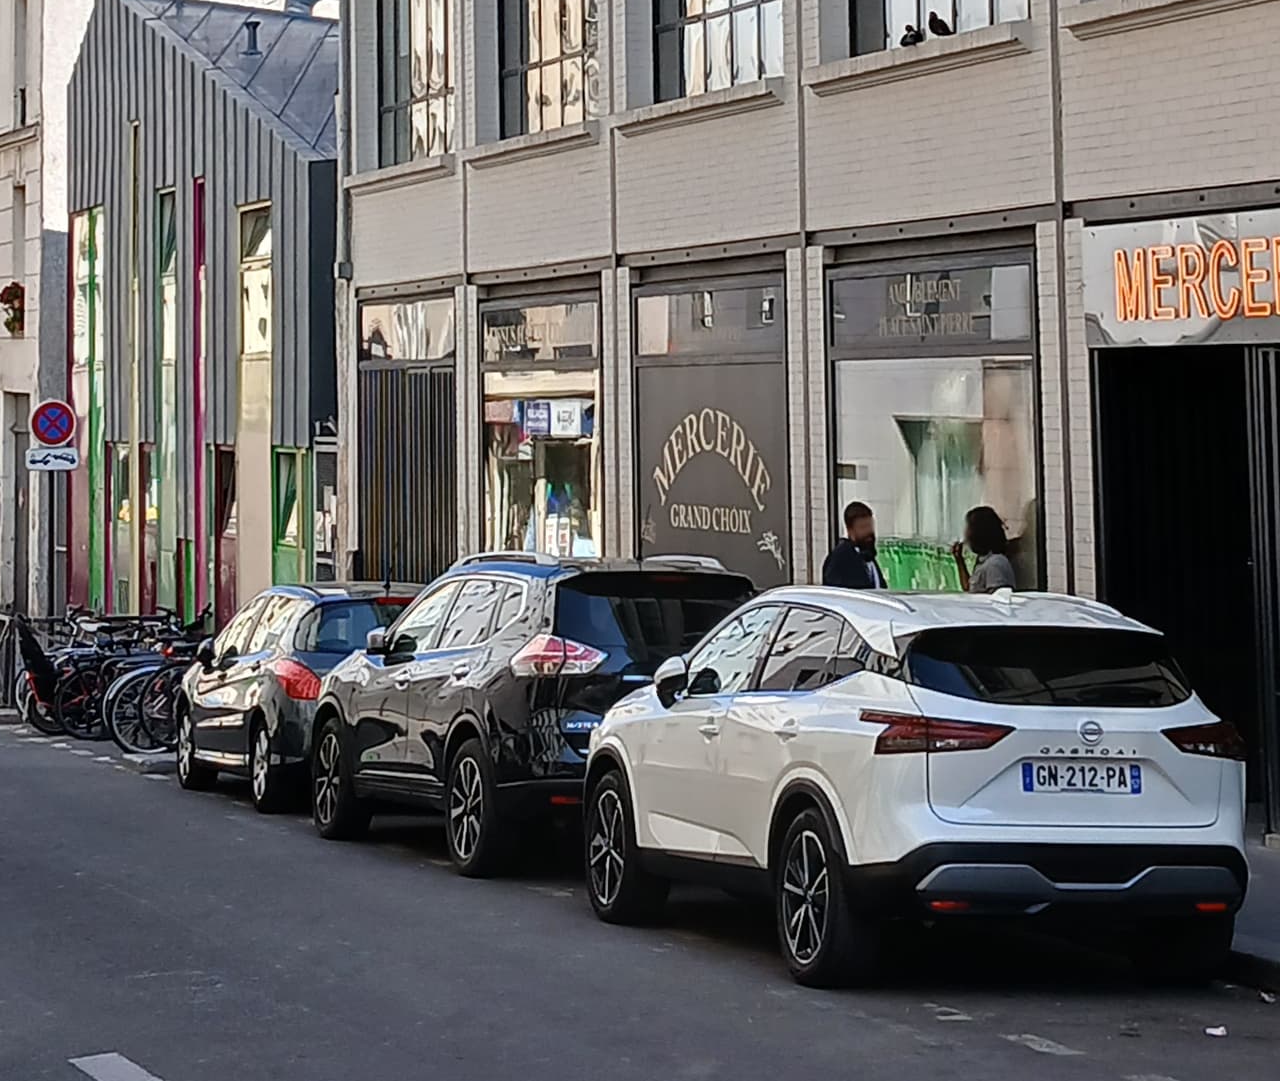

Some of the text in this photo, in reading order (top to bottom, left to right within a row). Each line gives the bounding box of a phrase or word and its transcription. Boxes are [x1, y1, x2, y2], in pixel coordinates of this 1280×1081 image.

[653, 408, 771, 512] MERCERIE
[670, 504, 751, 534] GRAND CHOIX
[1036, 765, 1128, 788] GN-212-PA
